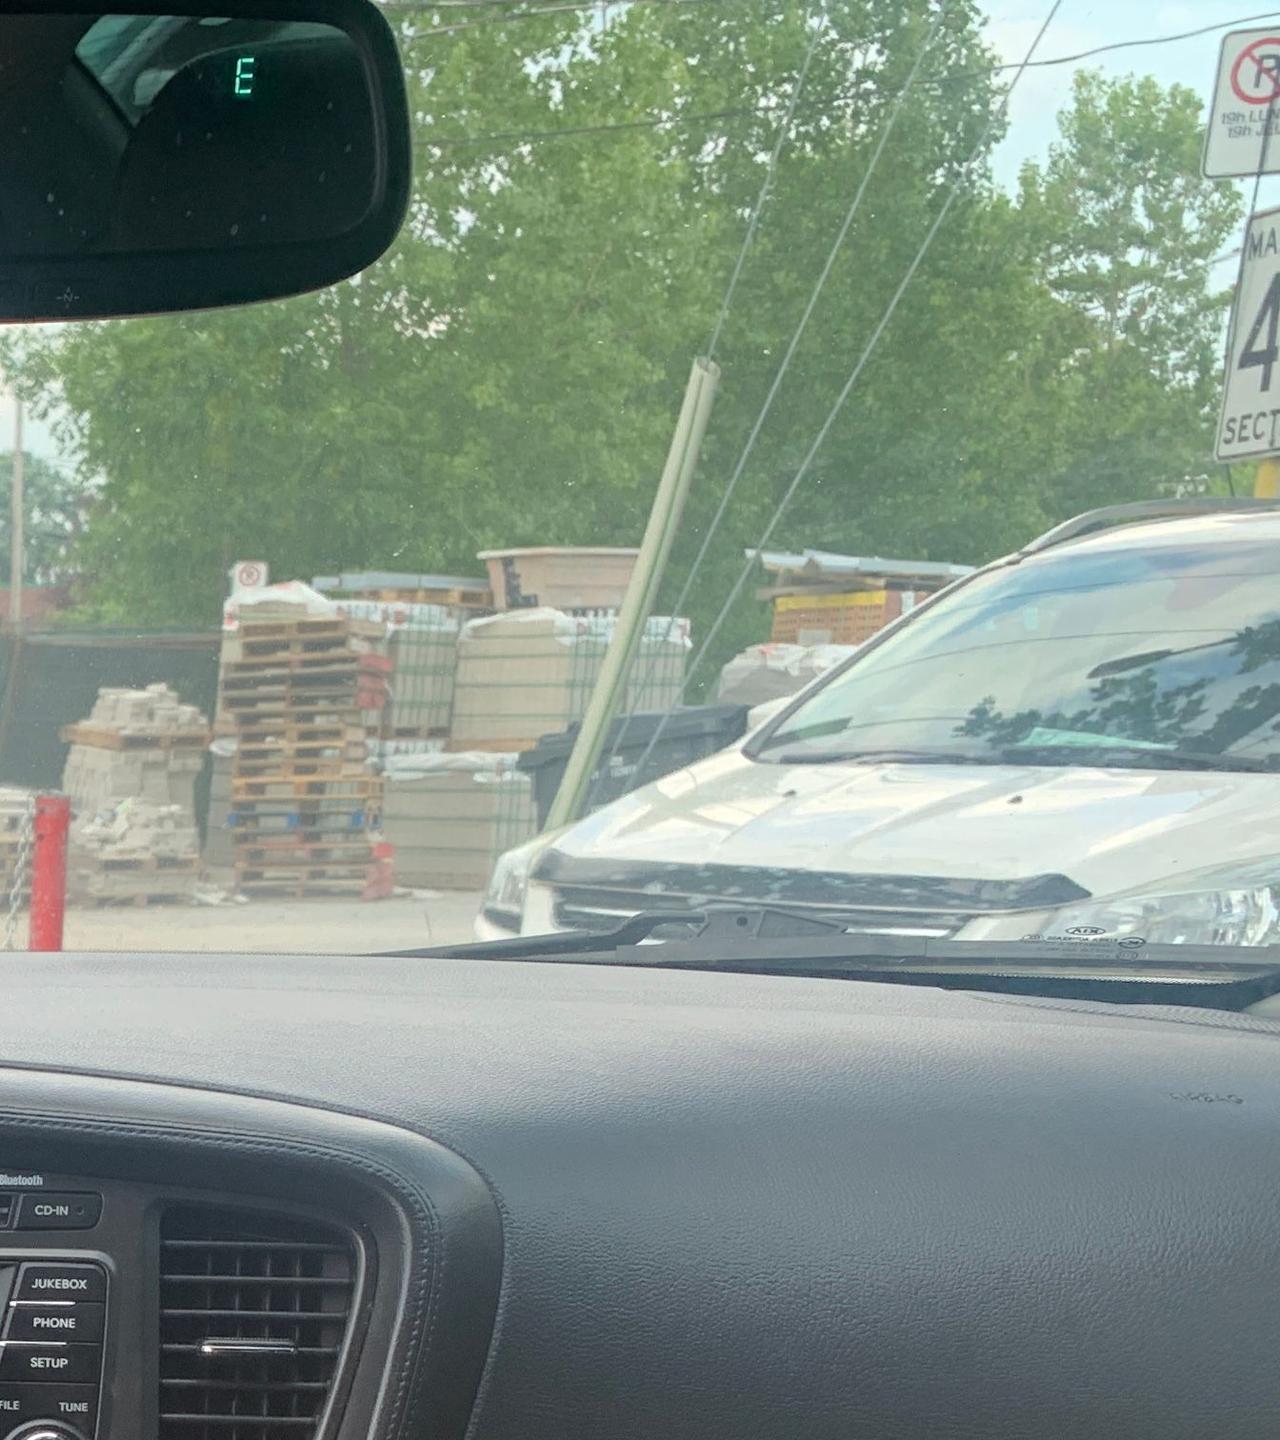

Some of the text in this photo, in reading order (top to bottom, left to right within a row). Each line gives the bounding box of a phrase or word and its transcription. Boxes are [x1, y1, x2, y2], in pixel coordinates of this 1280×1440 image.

[234, 58, 254, 95] E
[34, 1205, 69, 1217] CD-IN
[31, 1278, 87, 1290] JUKEBOX
[33, 1317, 76, 1329] PHONE
[30, 1357, 68, 1370] SETUP
[58, 1401, 89, 1413] TUNE
